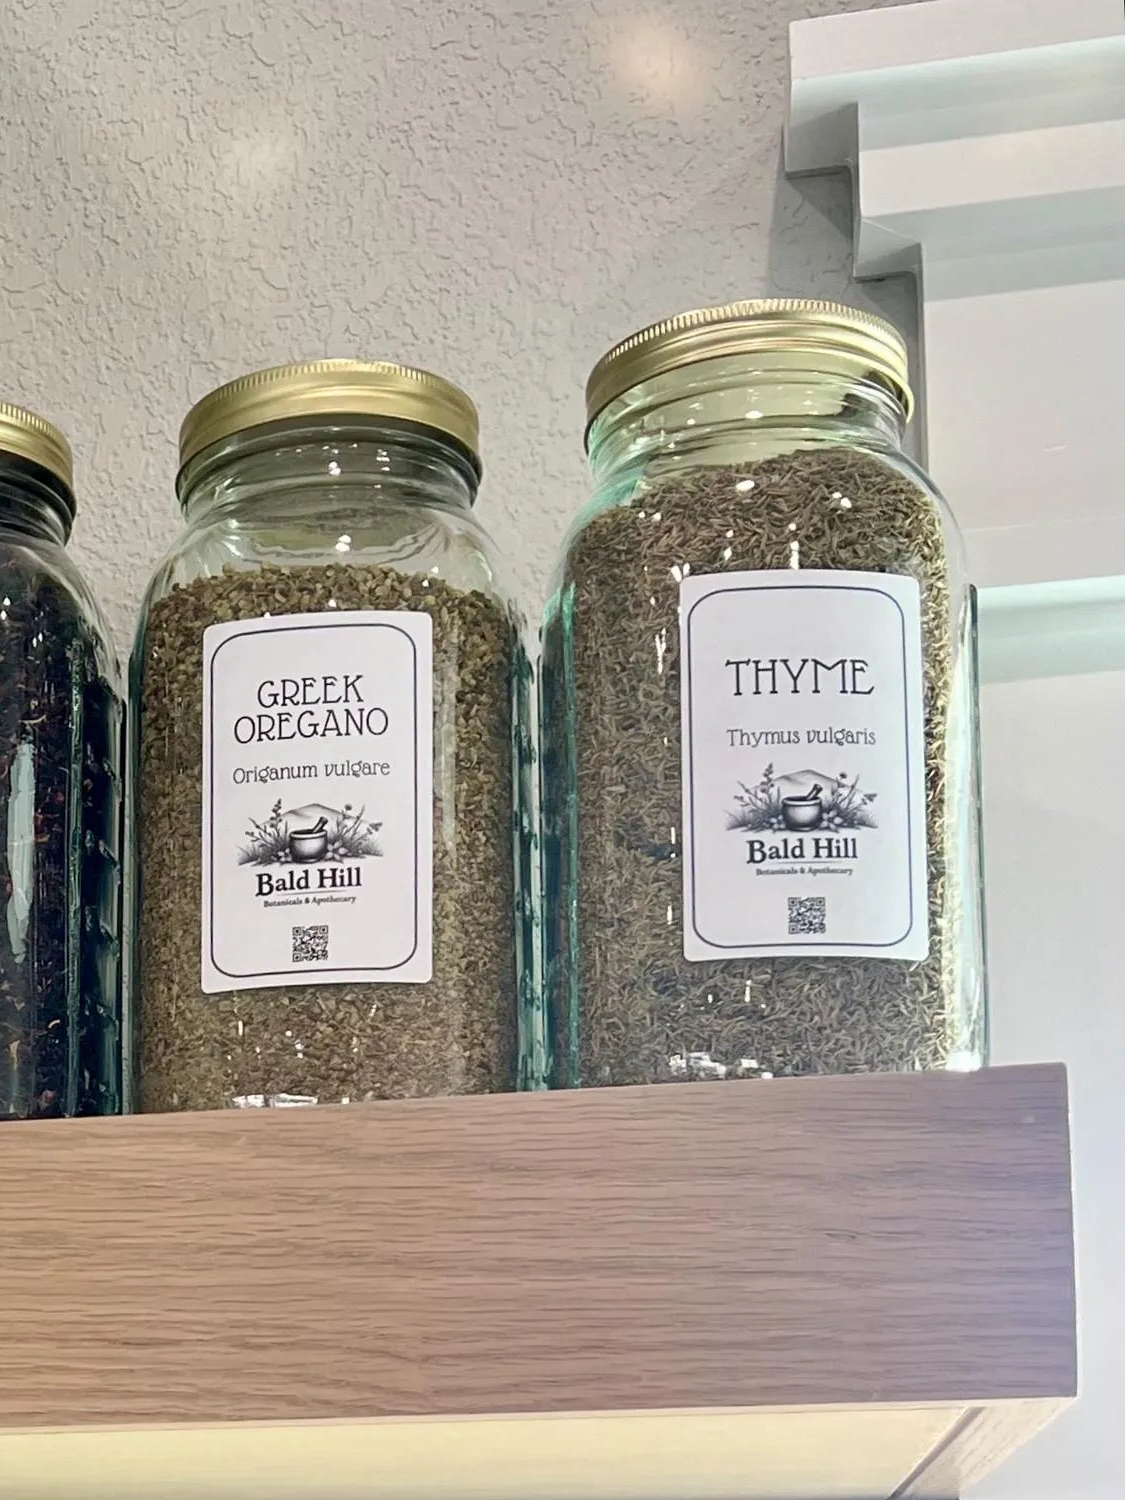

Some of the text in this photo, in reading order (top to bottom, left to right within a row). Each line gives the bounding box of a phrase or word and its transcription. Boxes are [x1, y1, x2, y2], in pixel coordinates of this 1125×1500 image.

[257, 674, 364, 708] GREEK
[725, 658, 875, 697] THYME
[233, 707, 389, 744] OREGANO
[726, 727, 877, 748] Thymus vulgaris
[232, 760, 391, 785] Origanum vulgare
[746, 838, 858, 864] Bald Hill
[255, 867, 363, 897] Bald Hill
